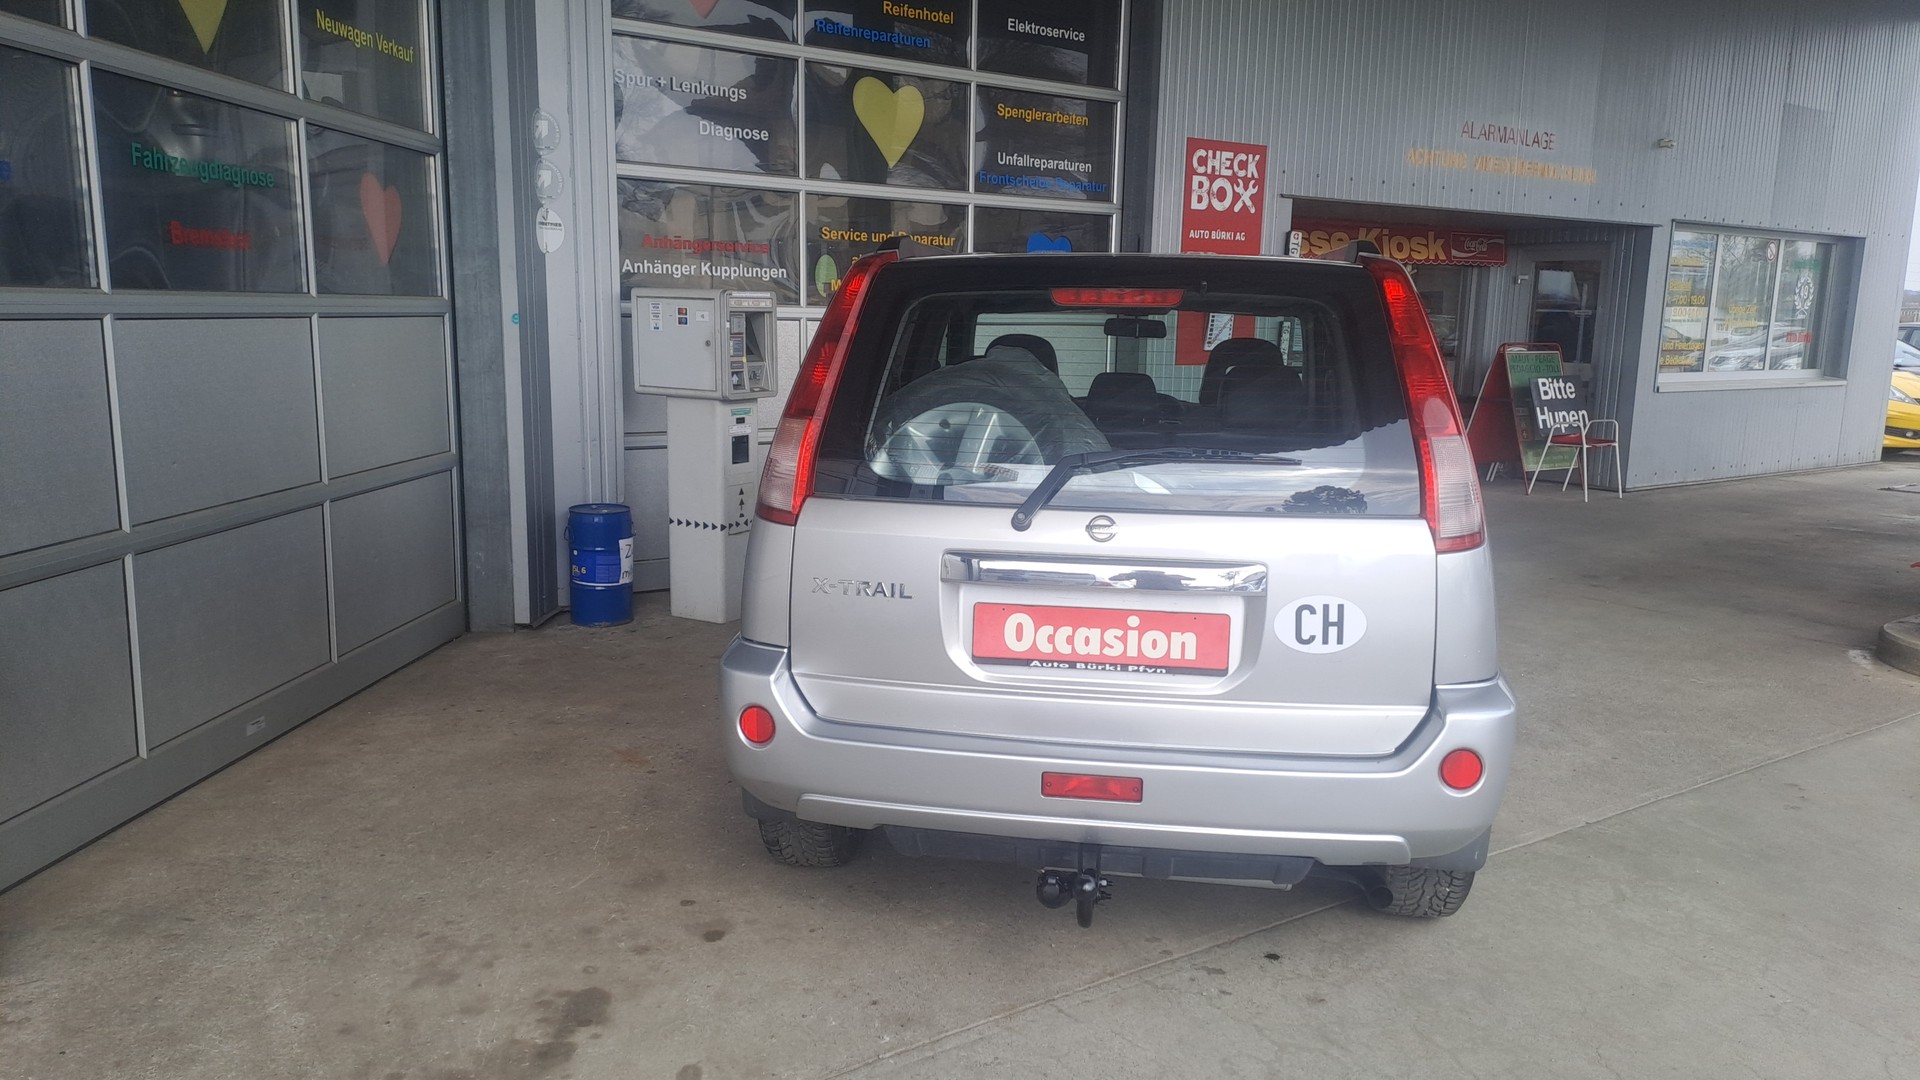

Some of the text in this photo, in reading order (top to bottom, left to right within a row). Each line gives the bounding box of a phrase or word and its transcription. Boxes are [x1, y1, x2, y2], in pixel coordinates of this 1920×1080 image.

[883, 1, 954, 24] Reifenhotel
[316, 9, 414, 62] Neuwagen Verkauf
[816, 19, 931, 49] Reifenreparaturen
[1007, 18, 1086, 42] Elektroservice
[614, 68, 653, 88] Spur
[671, 76, 747, 102] Lenkungs
[997, 103, 1089, 126] Spenglerarbeiten
[700, 121, 769, 141] Diagnose
[1461, 120, 1556, 150] ALARMANLAGE
[998, 152, 1092, 173] Unfallreparaturen
[1193, 149, 1260, 179] CHECK
[1191, 175, 1258, 214] BOX
[821, 226, 867, 242] Service
[1189, 229, 1246, 241] AUTO BÜRKI AG
[1359, 228, 1447, 260] Kiosk
[622, 259, 787, 281] Anhänger Kupplungen
[1537, 378, 1576, 400] Bitte
[1536, 406, 1589, 433] Hupen
[811, 577, 912, 599] X-TRAIL
[1003, 612, 1197, 660] Occasion
[1295, 604, 1344, 645] CH
[1029, 660, 1070, 669] Auto
[1075, 662, 1121, 672] Bürki
